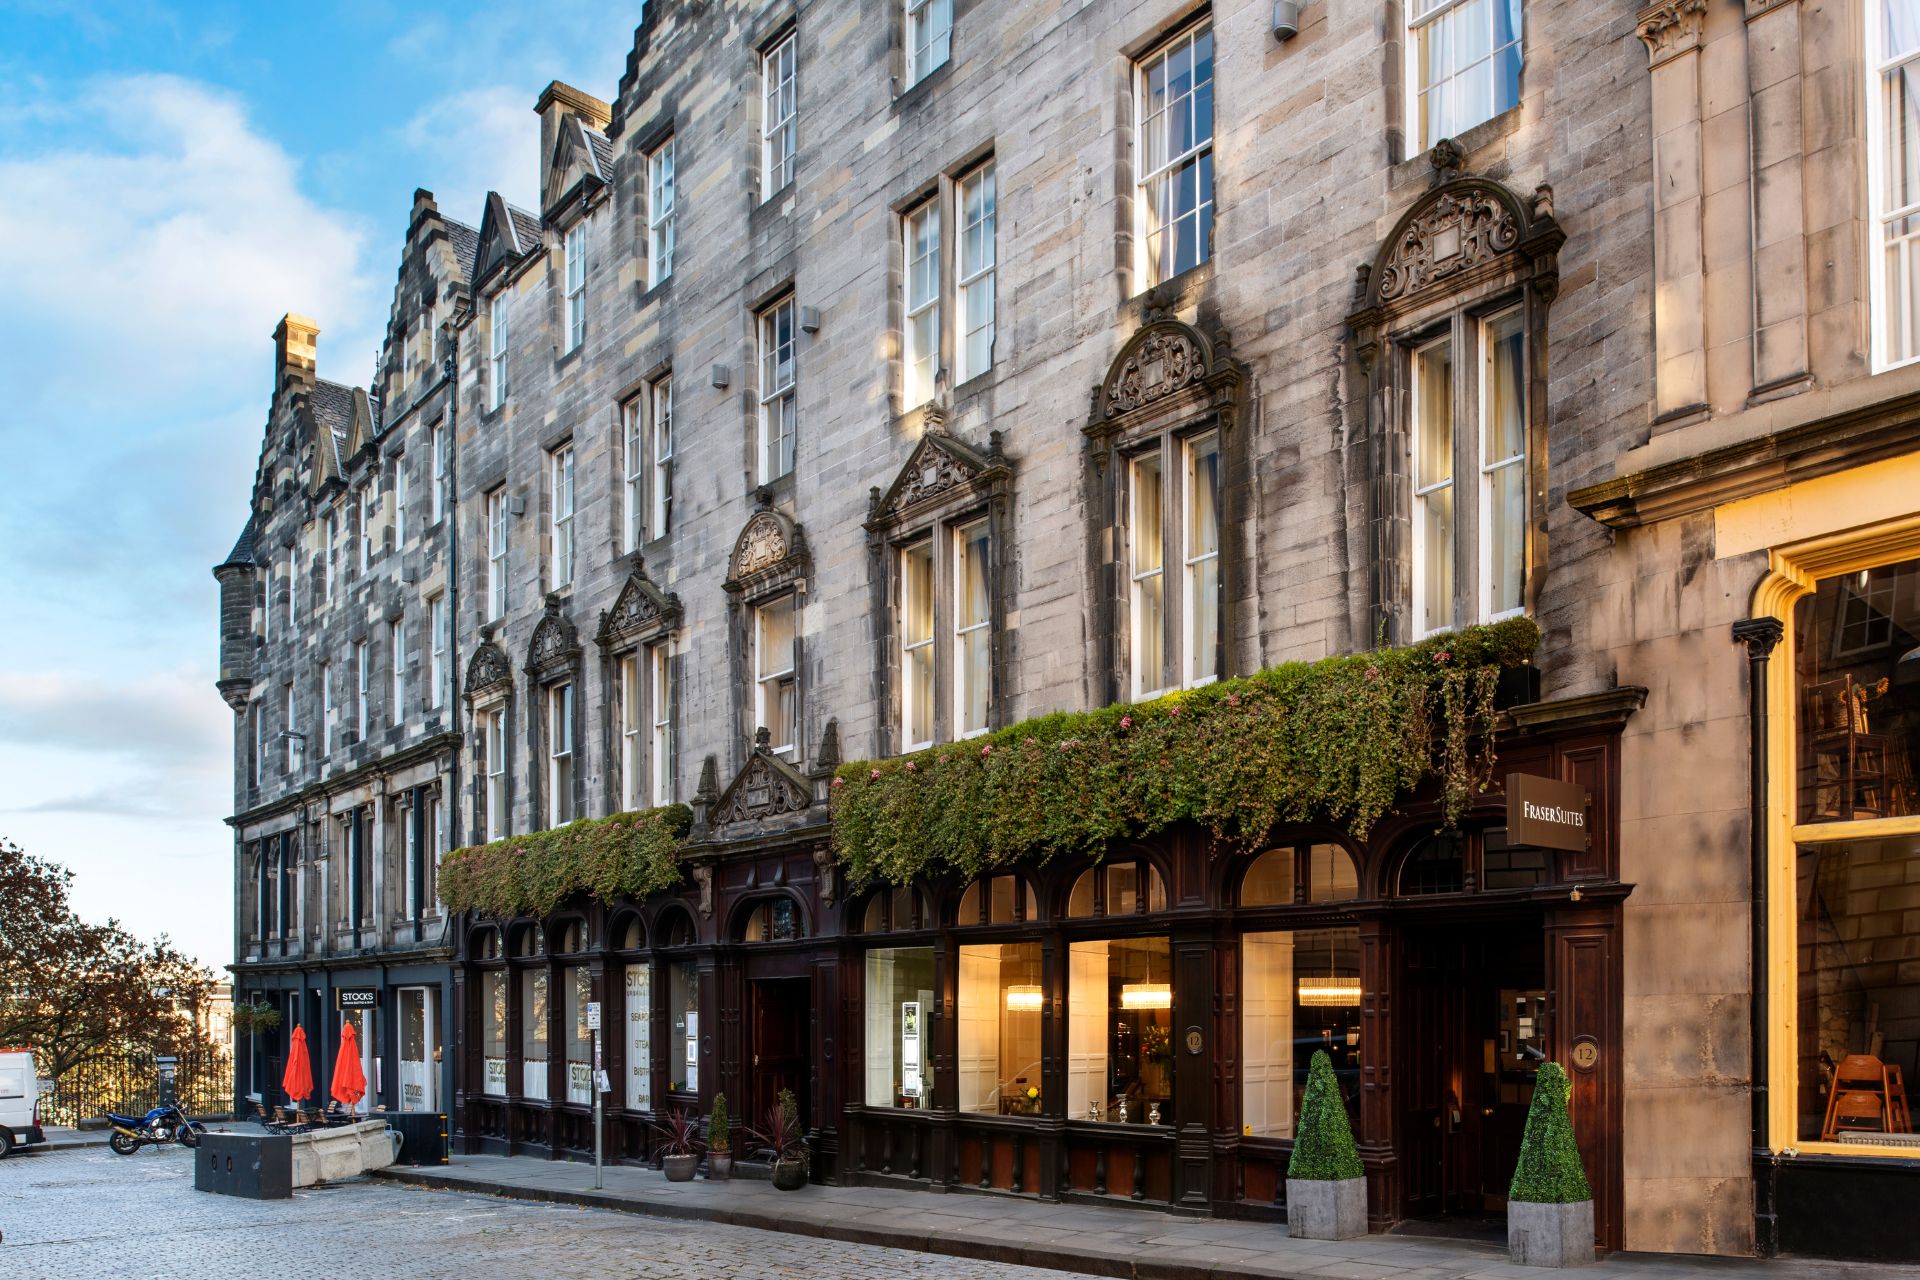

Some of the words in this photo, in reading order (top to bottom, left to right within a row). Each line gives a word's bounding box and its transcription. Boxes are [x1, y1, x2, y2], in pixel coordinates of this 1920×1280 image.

[342, 992, 374, 1001] STOCKS
[1190, 1036, 1200, 1046] 12
[1579, 1048, 1593, 1060] 12
